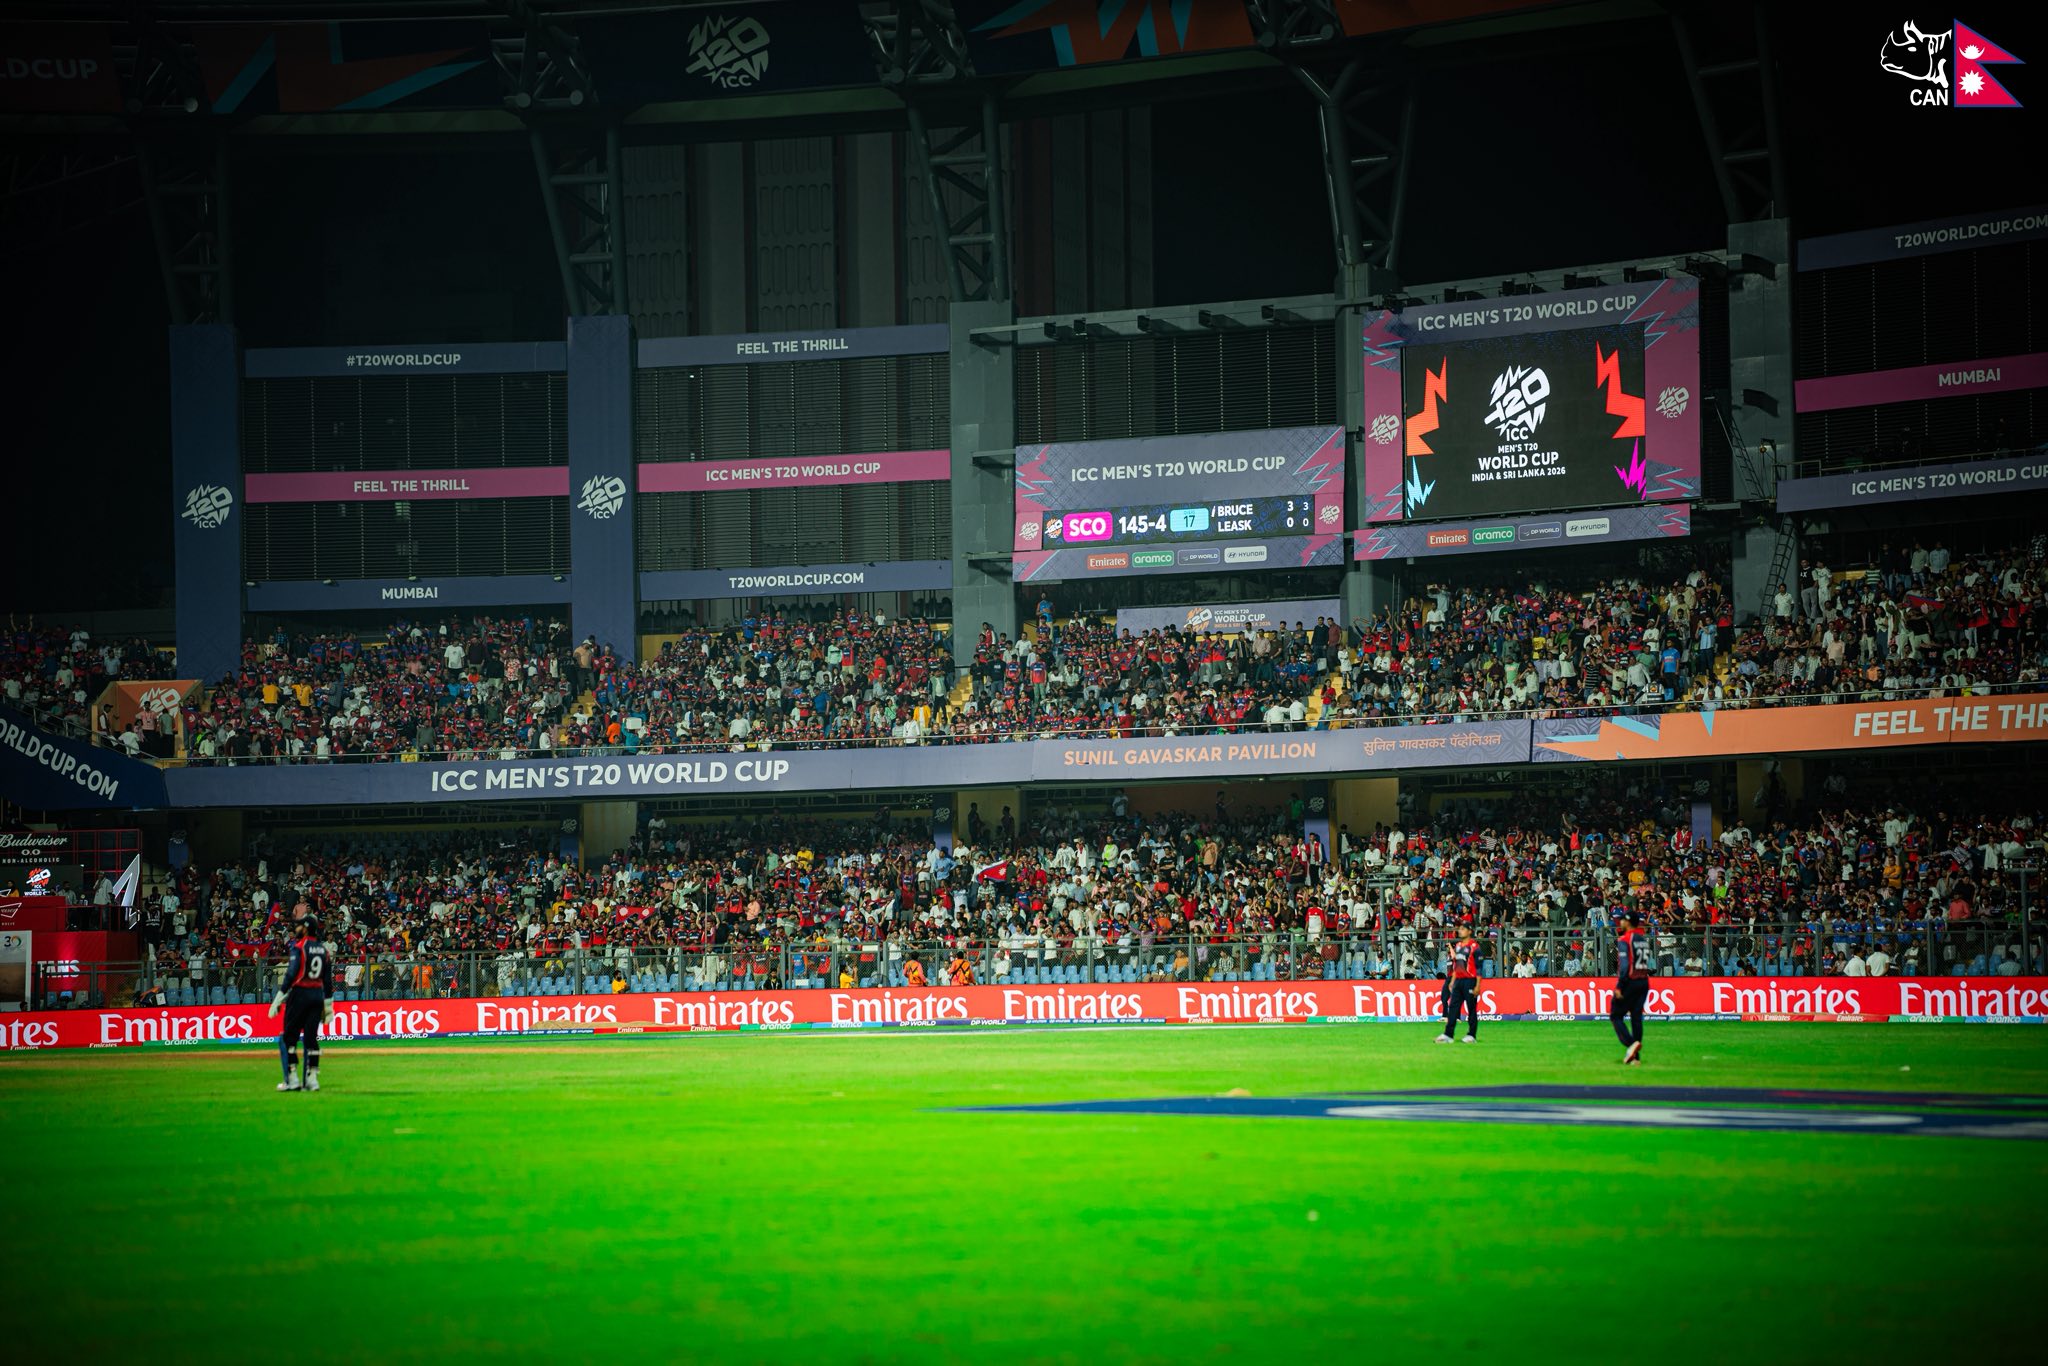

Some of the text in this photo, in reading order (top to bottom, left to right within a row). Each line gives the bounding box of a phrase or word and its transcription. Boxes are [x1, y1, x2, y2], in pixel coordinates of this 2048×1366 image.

[720, 75, 752, 88] ICC
[1895, 214, 2048, 249] T20WORLDCUP.COM
[1418, 295, 1637, 331] ICC MEN'S T20 WORLD CUP
[737, 338, 849, 355] FEEL THE THRILL
[346, 354, 461, 367] #T20WORLDCUP
[1938, 368, 2000, 387] MUMBAI
[1506, 427, 1529, 441] ICC
[1498, 443, 1538, 454] MEN'S T20
[1071, 456, 1286, 482] ICC MEN'S T20 WORLD CUP
[1478, 452, 1559, 471] WORLD CUP
[706, 462, 881, 481] ICC MEN'S T20 WORLD CUP
[1472, 467, 1566, 482] INDIA & SRI LANKA 2026
[354, 479, 470, 493] FEEL THE THRILL
[1852, 481, 1876, 495] ICC
[1880, 476, 1925, 492] MEN'S
[1929, 473, 1957, 488] T20
[1959, 468, 2017, 485] WORLD
[593, 511, 610, 519] ICC
[1217, 501, 1309, 517] BRUCE 3 3
[198, 520, 216, 529] ICC
[1069, 517, 1107, 537] SCO
[1118, 514, 1167, 534] 145-4
[1183, 514, 1196, 528] 17
[1218, 517, 1309, 532] LEASK 0 0
[1580, 523, 1607, 531] HYUNDAI
[1430, 533, 1467, 545] Emirates
[1475, 530, 1513, 540] aramco
[1090, 556, 1126, 568] Emirates
[1134, 554, 1172, 564] aramco
[729, 572, 864, 588] T20WORLDCUP.COM
[382, 587, 438, 600] MUMBAI
[1214, 613, 1266, 623] WORLD CUP
[1853, 709, 1925, 737] FEEL
[1933, 706, 1990, 732] THE
[1064, 742, 1316, 766] SUNIL GAVASKAR PAVILION
[1363, 737, 1396, 756] सुनिल
[1399, 738, 1446, 750] गावसकर
[431, 759, 790, 792] ICC MEN'S T20 WORLD CUP
[0, 833, 68, 848] Budweiser
[308, 955, 323, 979] 9
[830, 991, 968, 1022] Emirates
[1003, 988, 1143, 1020] Emirates
[1177, 985, 1318, 1018] Emirates
[1533, 981, 1676, 1016] Emires
[1711, 981, 1861, 1014] Emirates
[1899, 981, 2048, 1017] Emirates
[476, 1000, 617, 1032] Emirates
[653, 995, 795, 1025] Emirates
[1910, 1015, 1944, 1023] aramco
[99, 1010, 253, 1043] Emirates
[317, 1004, 438, 1037] mirates
